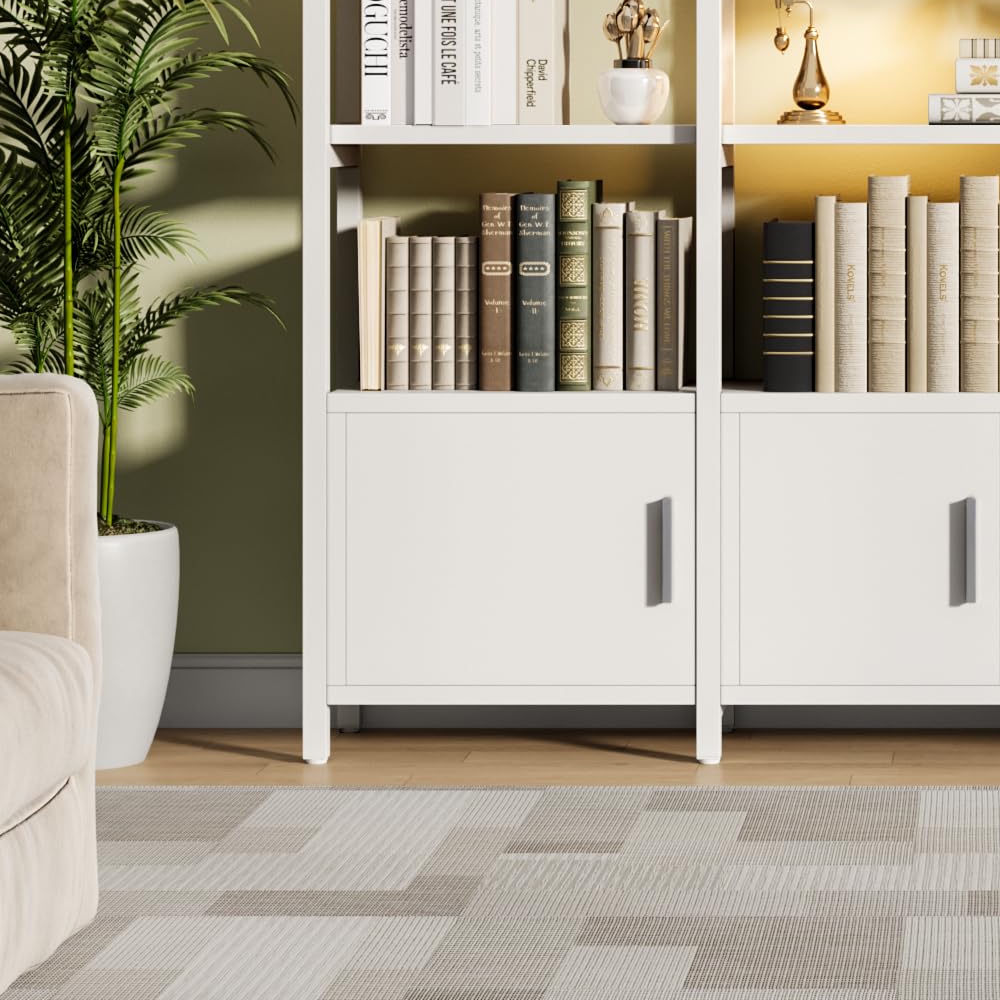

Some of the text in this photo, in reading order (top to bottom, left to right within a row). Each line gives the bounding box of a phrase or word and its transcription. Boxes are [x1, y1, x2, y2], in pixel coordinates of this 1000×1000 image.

[440, 5, 457, 23] UNE
[440, 26, 457, 46] FOIS
[440, 48, 457, 60] LE
[440, 62, 460, 85] CAFÉ
[538, 59, 548, 81] David
[525, 59, 537, 107] Chipperfield
